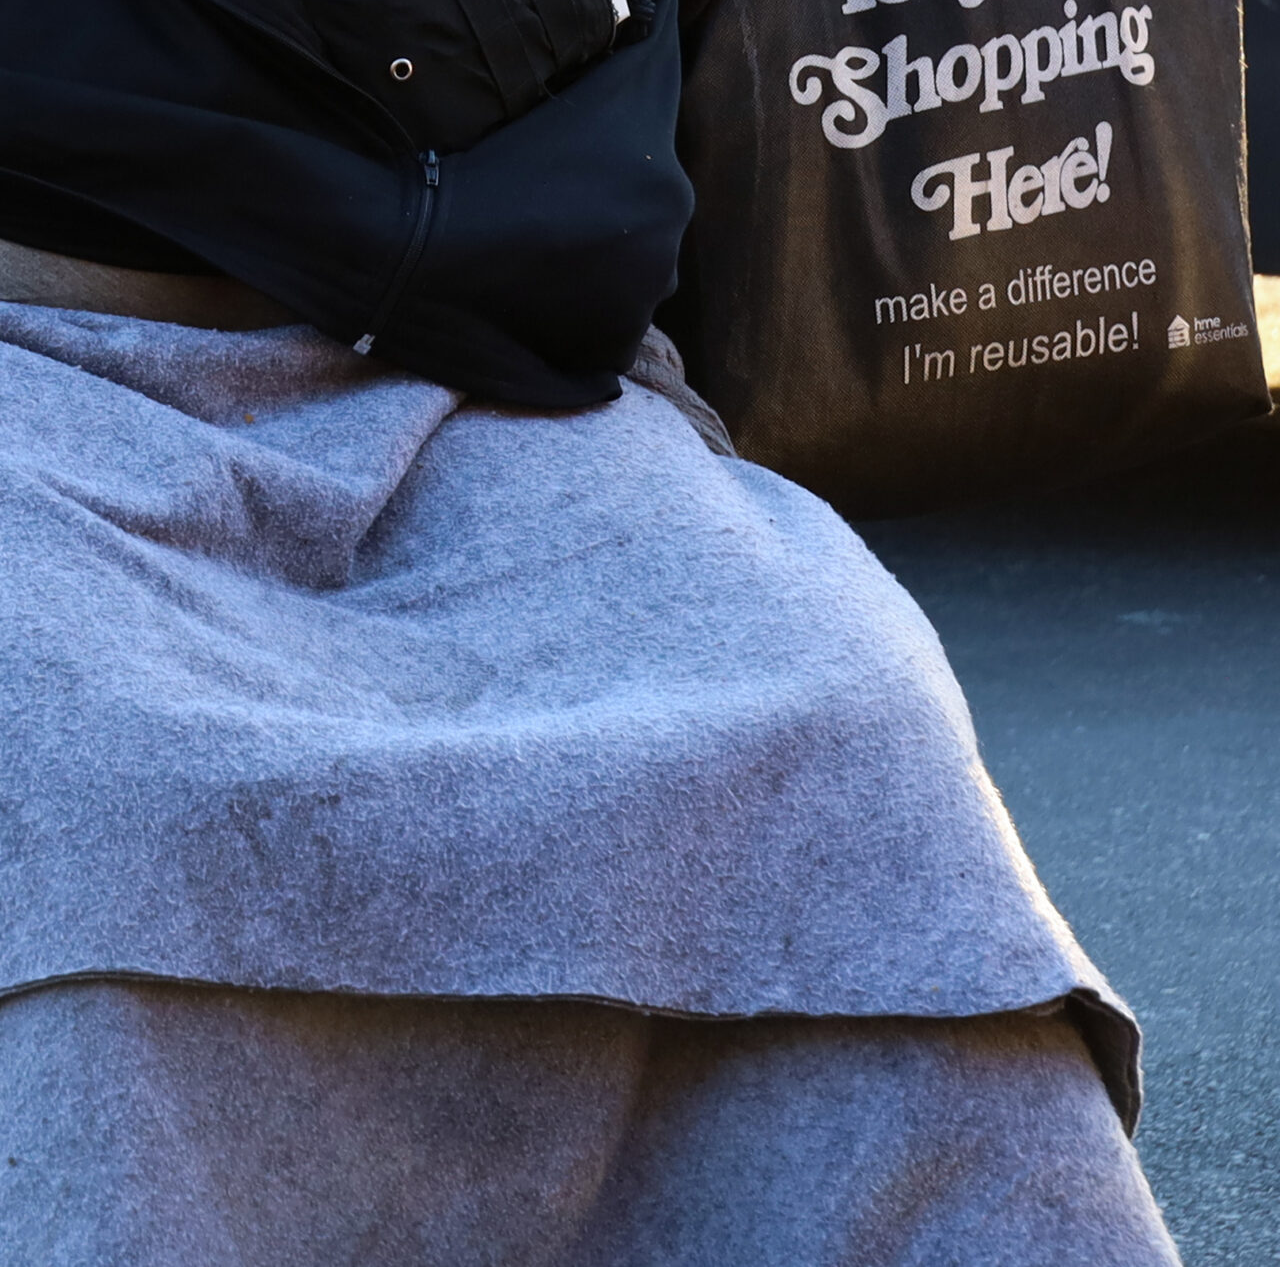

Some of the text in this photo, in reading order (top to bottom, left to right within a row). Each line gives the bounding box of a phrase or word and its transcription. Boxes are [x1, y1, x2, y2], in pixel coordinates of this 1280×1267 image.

[789, 0, 1155, 149] Shopping
[910, 121, 1113, 241] Here!
[874, 256, 1157, 324] make a difference
[902, 311, 1140, 385] I'm reusable!
[1194, 322, 1249, 344] essentials
